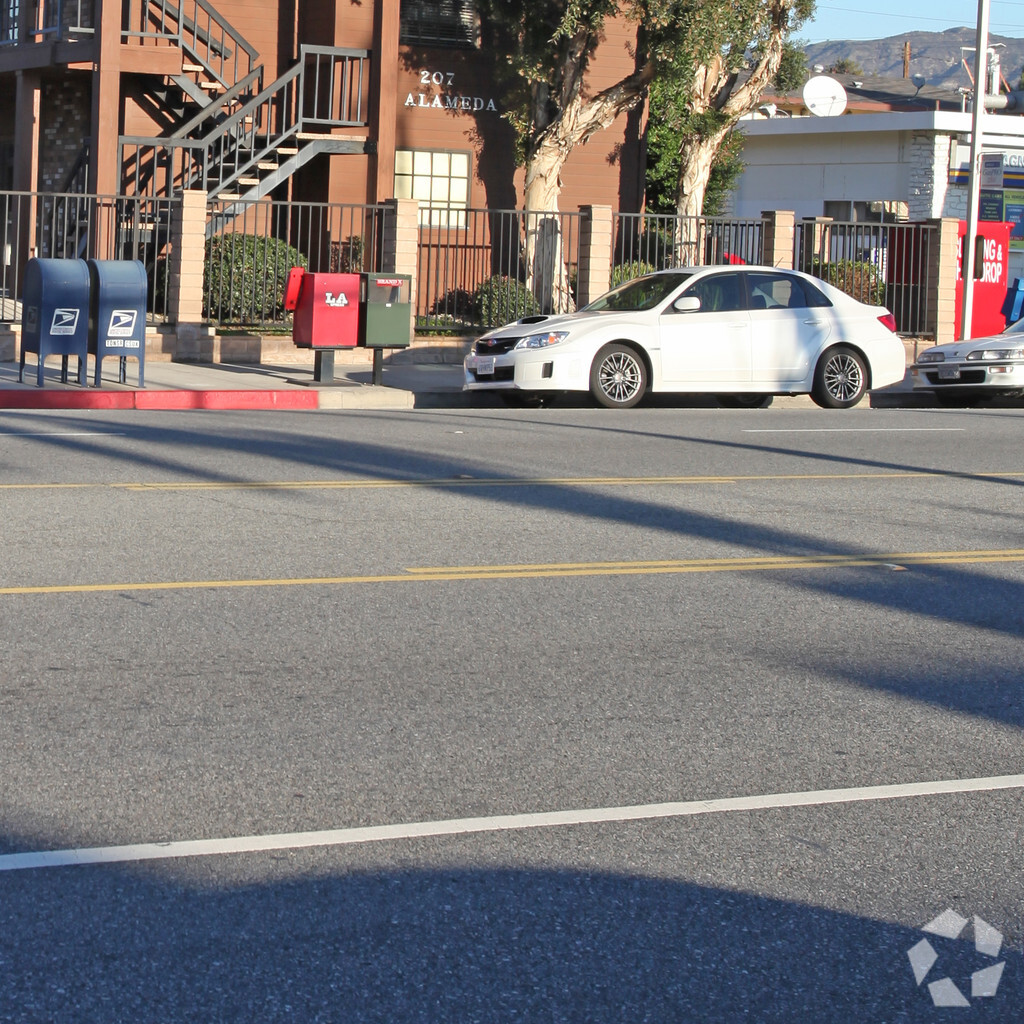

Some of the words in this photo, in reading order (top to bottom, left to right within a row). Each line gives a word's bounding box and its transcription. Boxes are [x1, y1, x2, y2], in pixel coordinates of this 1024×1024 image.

[420, 70, 455, 86] 207
[404, 92, 498, 111] ALAMEDA
[997, 244, 1003, 261] &
[325, 292, 348, 304] LA
